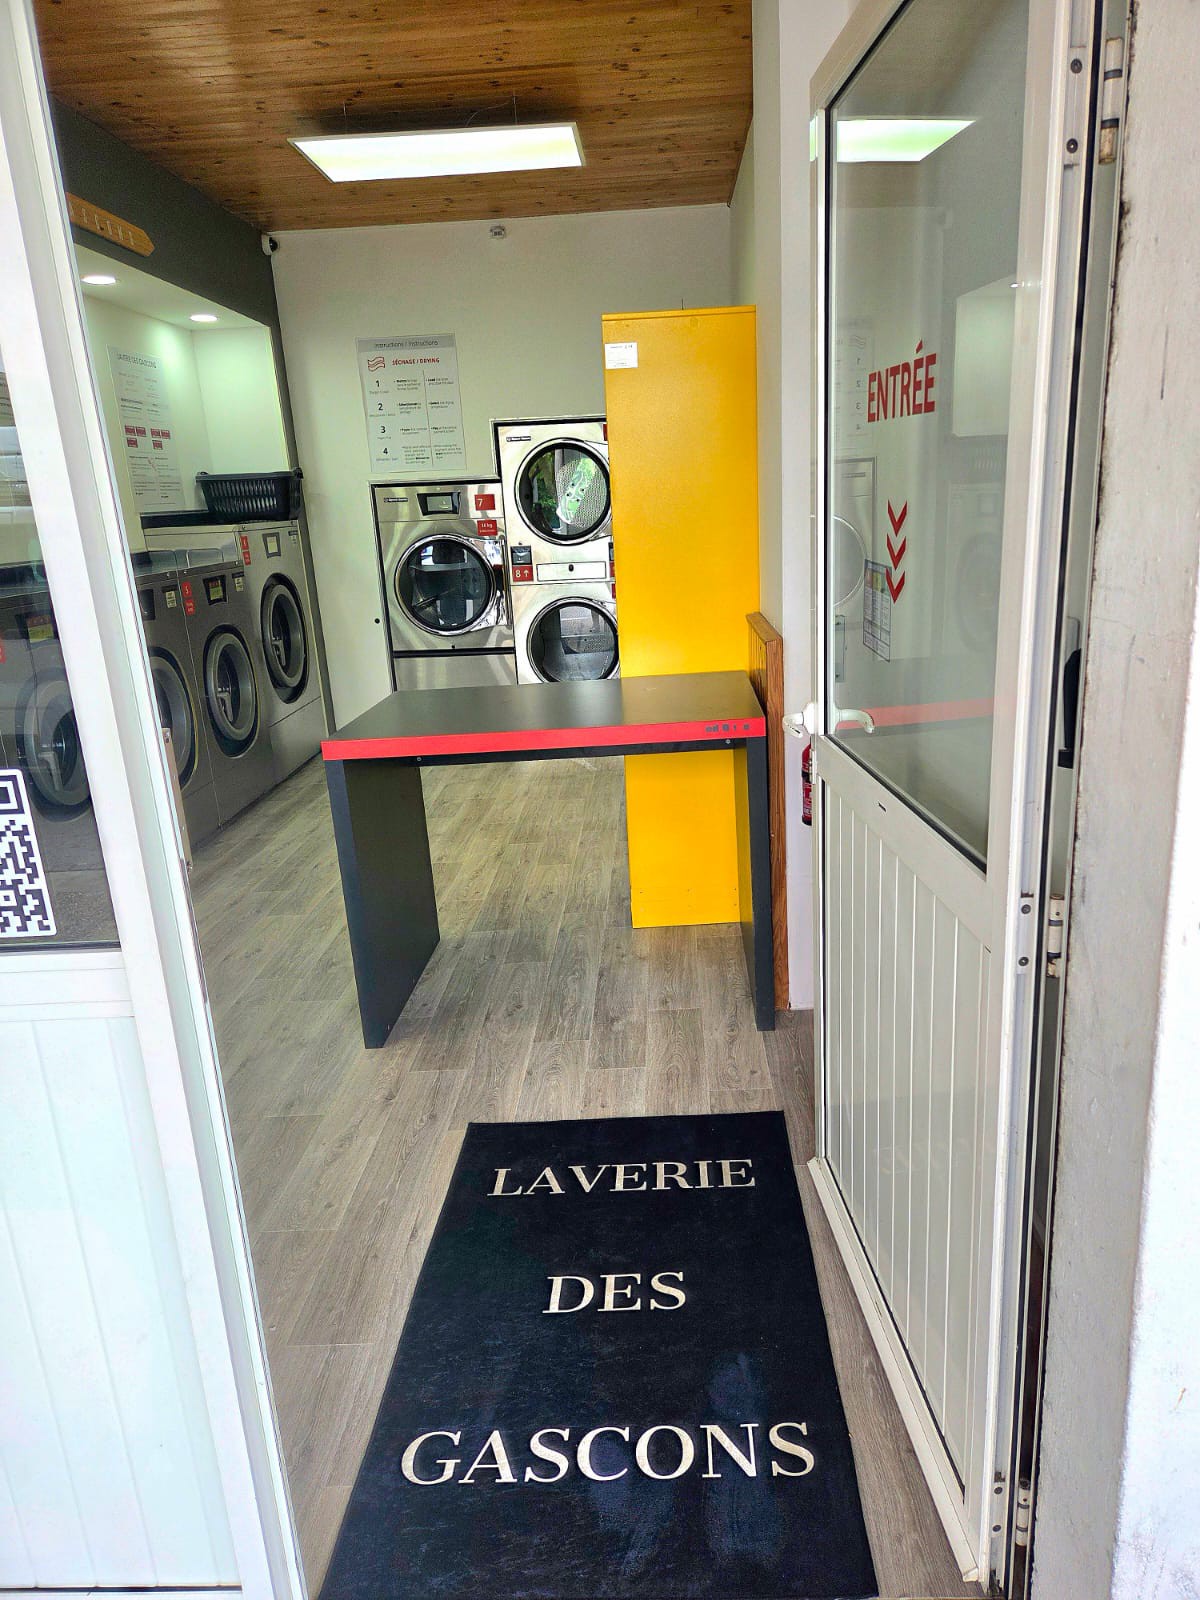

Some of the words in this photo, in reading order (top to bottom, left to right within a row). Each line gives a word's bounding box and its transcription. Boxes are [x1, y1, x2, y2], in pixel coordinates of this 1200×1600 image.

[867, 339, 937, 423] ENTRÉE
[378, 402, 383, 411] 2
[380, 425, 386, 434] 3
[383, 447, 388, 455] 4
[477, 498, 483, 508] 7
[515, 569, 521, 578] 8
[487, 1159, 756, 1196] LAVERIE
[542, 1271, 686, 1314] DES
[401, 1422, 815, 1485] GASCONS
